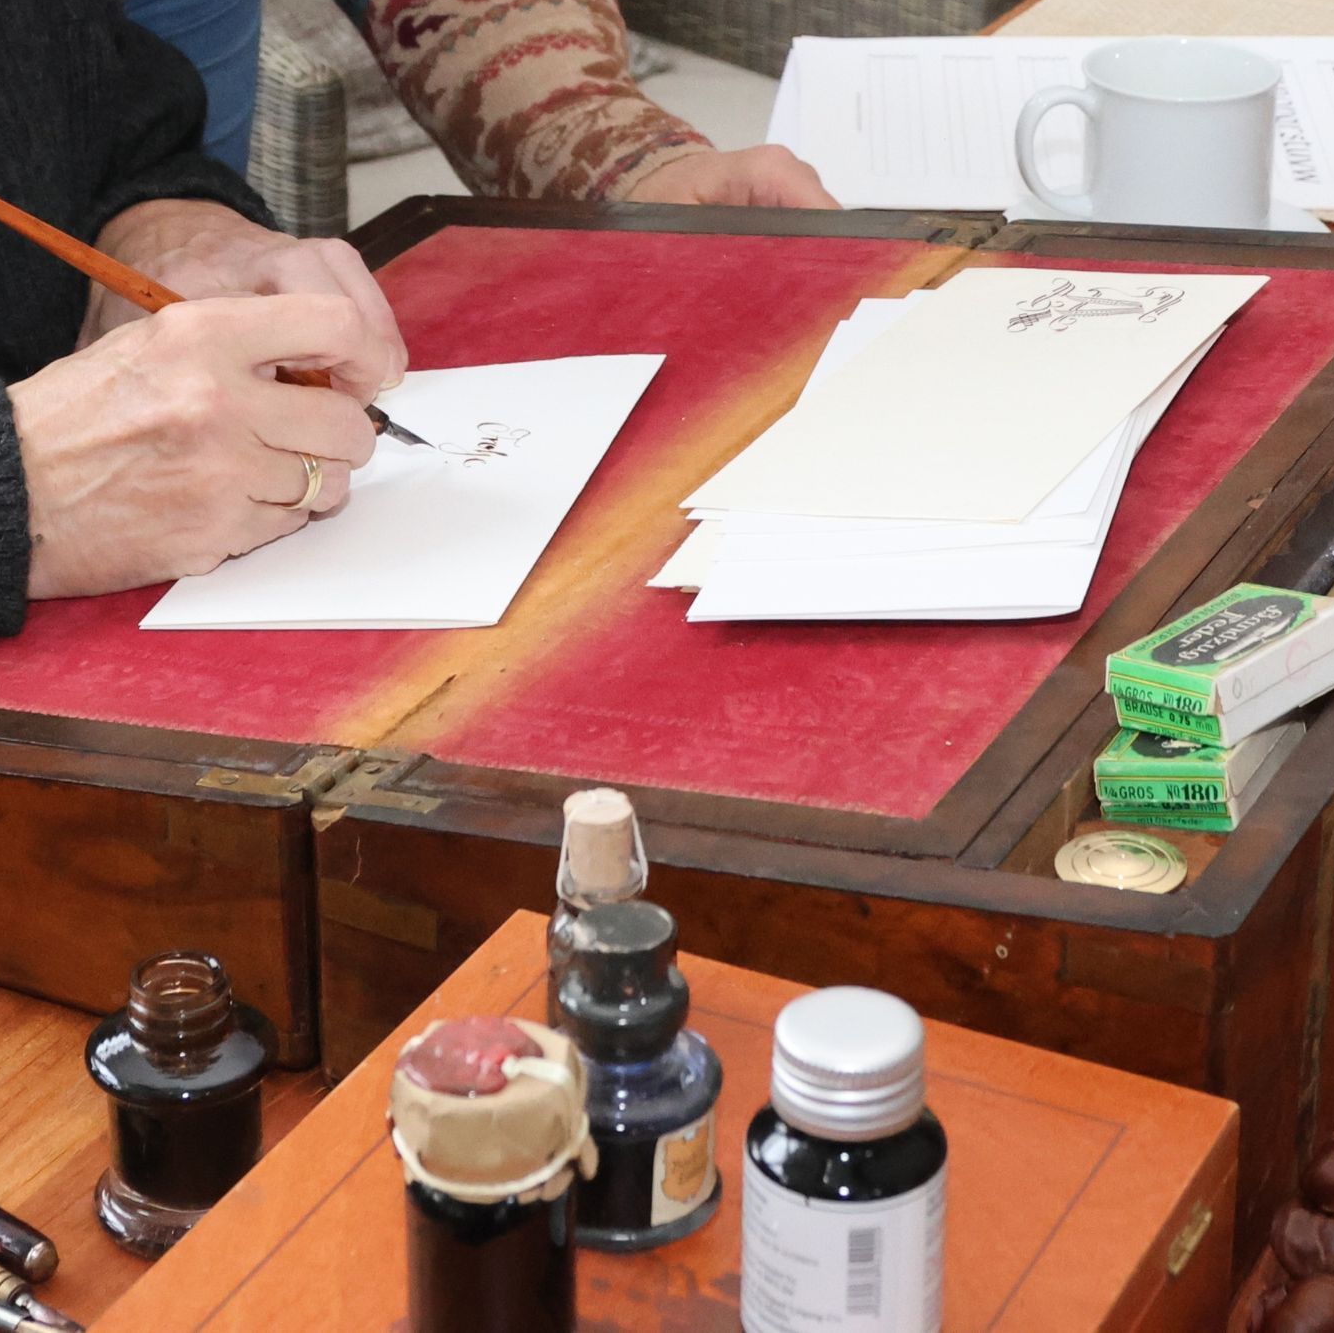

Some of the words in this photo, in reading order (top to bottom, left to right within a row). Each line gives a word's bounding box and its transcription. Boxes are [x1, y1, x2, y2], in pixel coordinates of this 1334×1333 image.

[1178, 608, 1248, 649] Feder
[1124, 686, 1153, 703] GROS
[1175, 695, 1203, 713] 180
[1124, 700, 1164, 719] BRAUSE
[1119, 786, 1154, 800] GROS
[1182, 783, 1218, 802] 180
